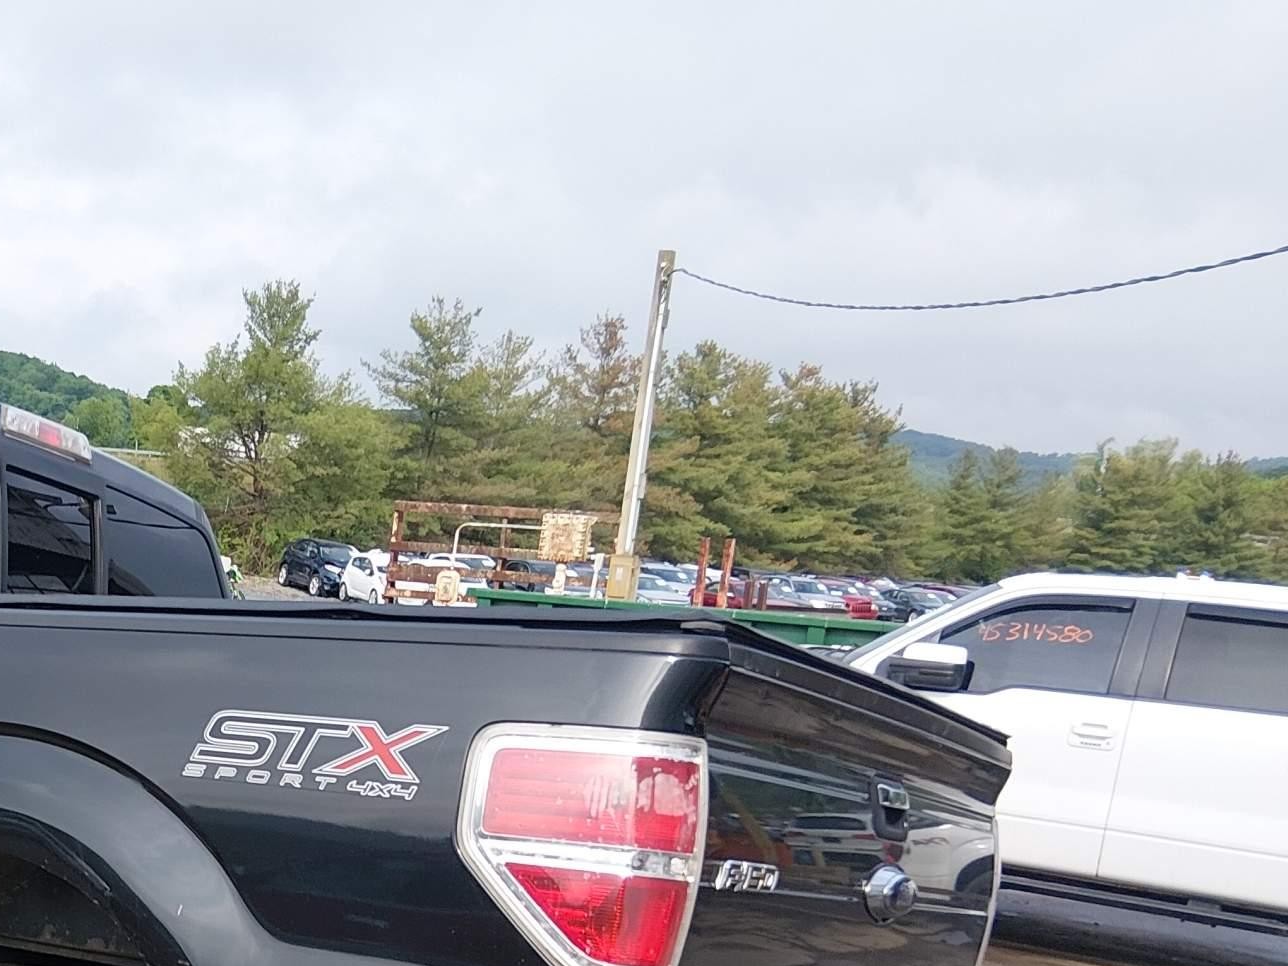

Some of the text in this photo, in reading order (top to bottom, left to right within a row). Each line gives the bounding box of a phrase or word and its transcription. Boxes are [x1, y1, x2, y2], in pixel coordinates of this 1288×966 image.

[978, 622, 1094, 643] 45314580
[189, 708, 450, 784] STX
[181, 762, 337, 791] SPORT
